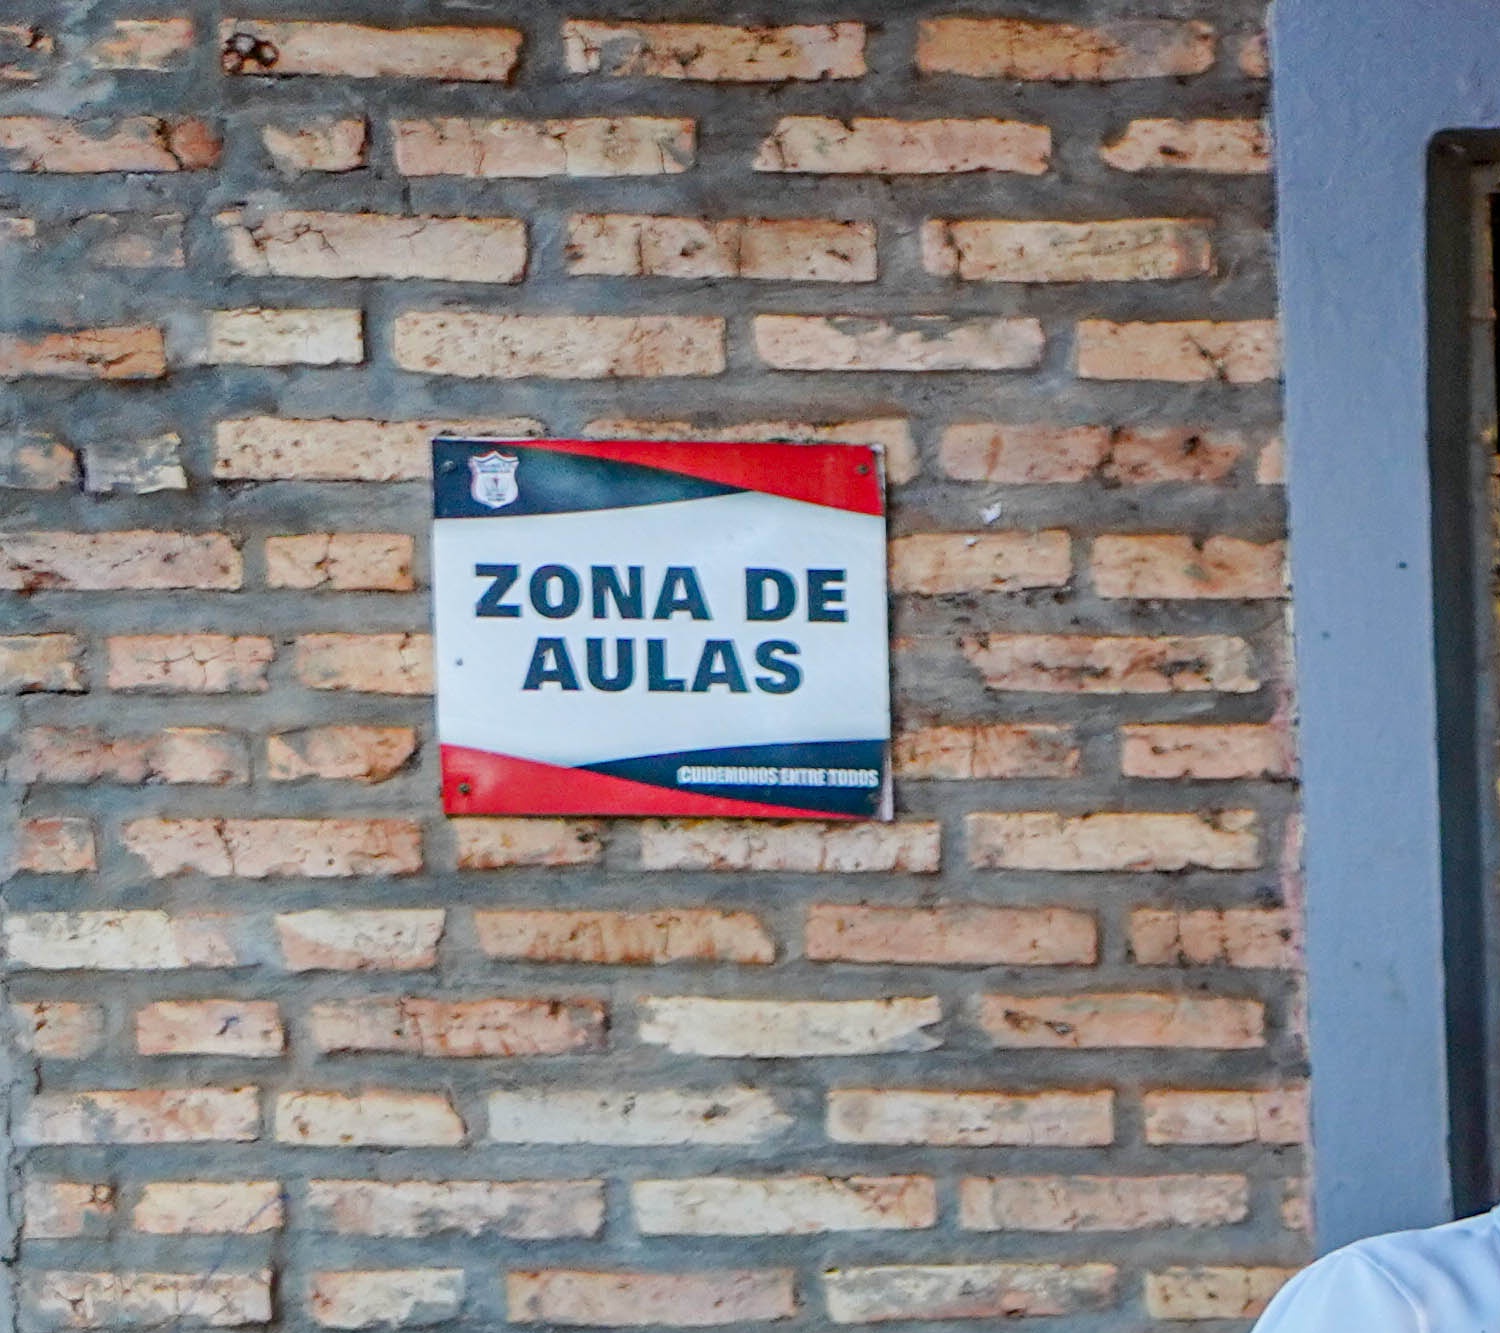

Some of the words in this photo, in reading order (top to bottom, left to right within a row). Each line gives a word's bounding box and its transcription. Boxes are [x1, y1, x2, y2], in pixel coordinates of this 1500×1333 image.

[473, 562, 713, 621] ZONA
[744, 567, 849, 623] DE
[521, 636, 805, 695] AULAS
[779, 767, 827, 786] ENTRE
[827, 768, 880, 788] TODOS
